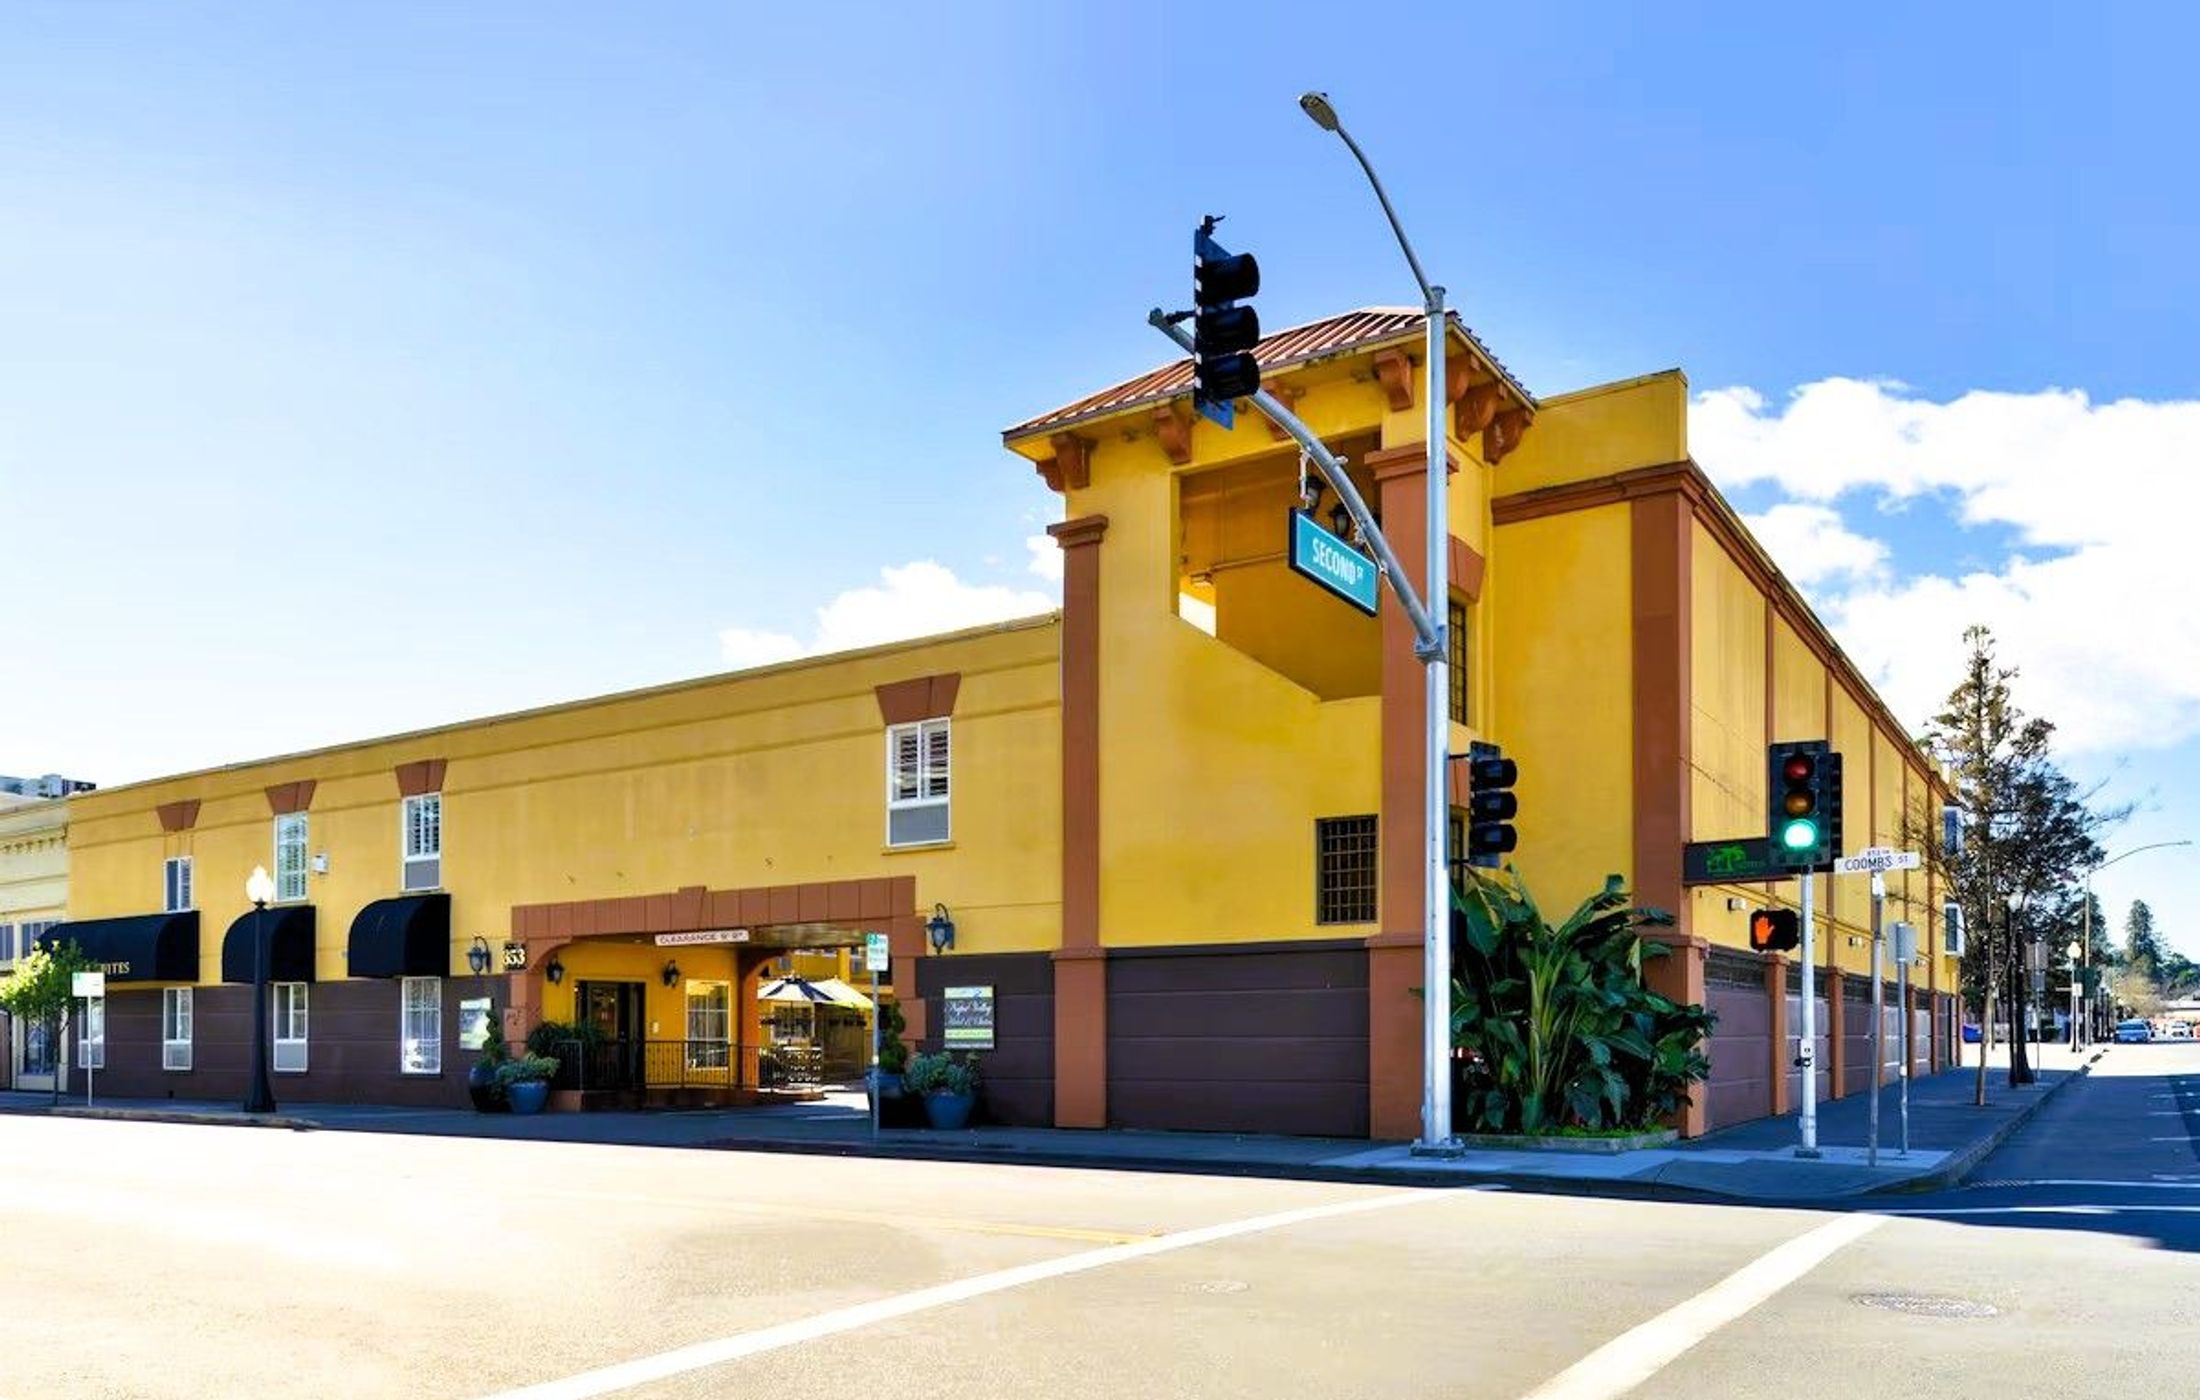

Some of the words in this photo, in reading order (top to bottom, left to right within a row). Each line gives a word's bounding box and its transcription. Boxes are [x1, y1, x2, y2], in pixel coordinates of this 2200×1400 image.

[1312, 538, 1356, 585] SECOND
[1845, 855, 1893, 871] COOMBS
[1898, 855, 1908, 864] ST
[660, 933, 716, 944] CLEARANCE
